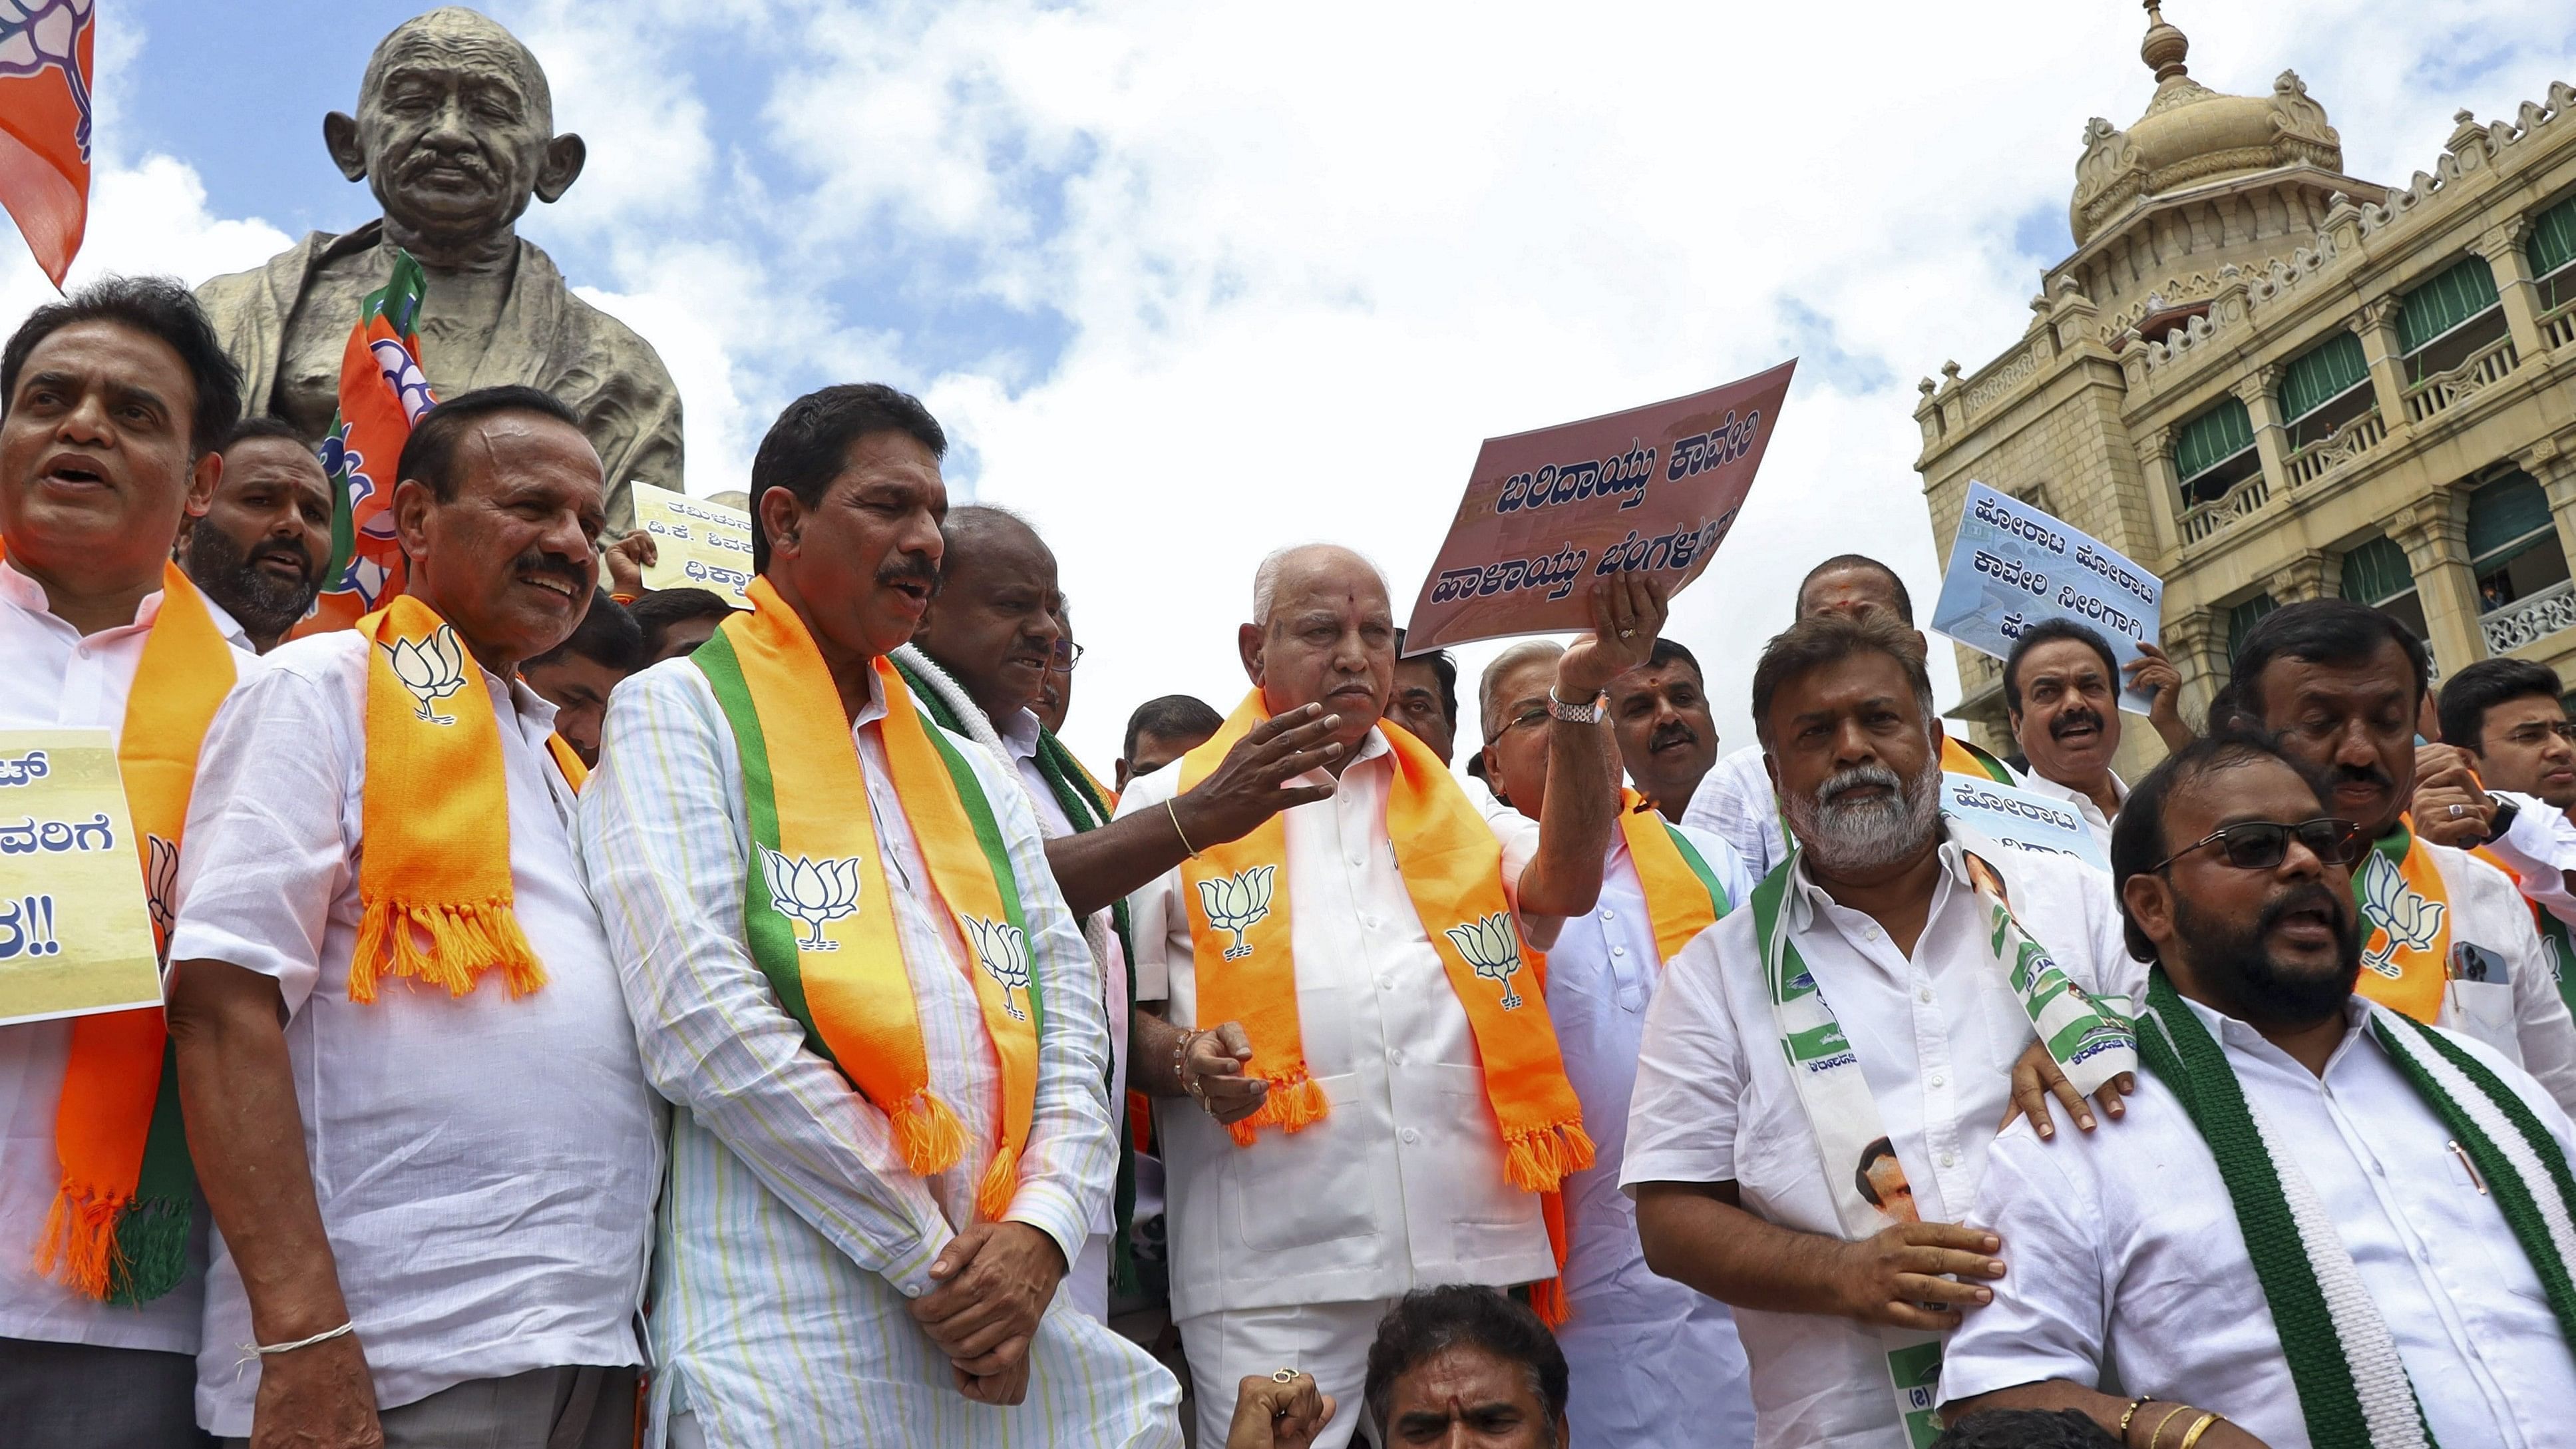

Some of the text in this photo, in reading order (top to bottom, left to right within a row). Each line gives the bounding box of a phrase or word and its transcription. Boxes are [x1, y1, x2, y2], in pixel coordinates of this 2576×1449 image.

[1495, 409, 1760, 512] ಬರಿದಾಯ್ತು ಕಾವೇರಿ
[1430, 542, 1588, 602] ಹಾಳಾಯ್ತು
[1973, 550, 2049, 596] ಕಾವೇರಿ
[2058, 586, 2145, 642] ನೀರಿಗಾಗಿ
[1974, 497, 2155, 604] ಹೋರಾಟ ಹೋರಾಟ
[1952, 783, 2078, 831] ಹೋರಾಟ
